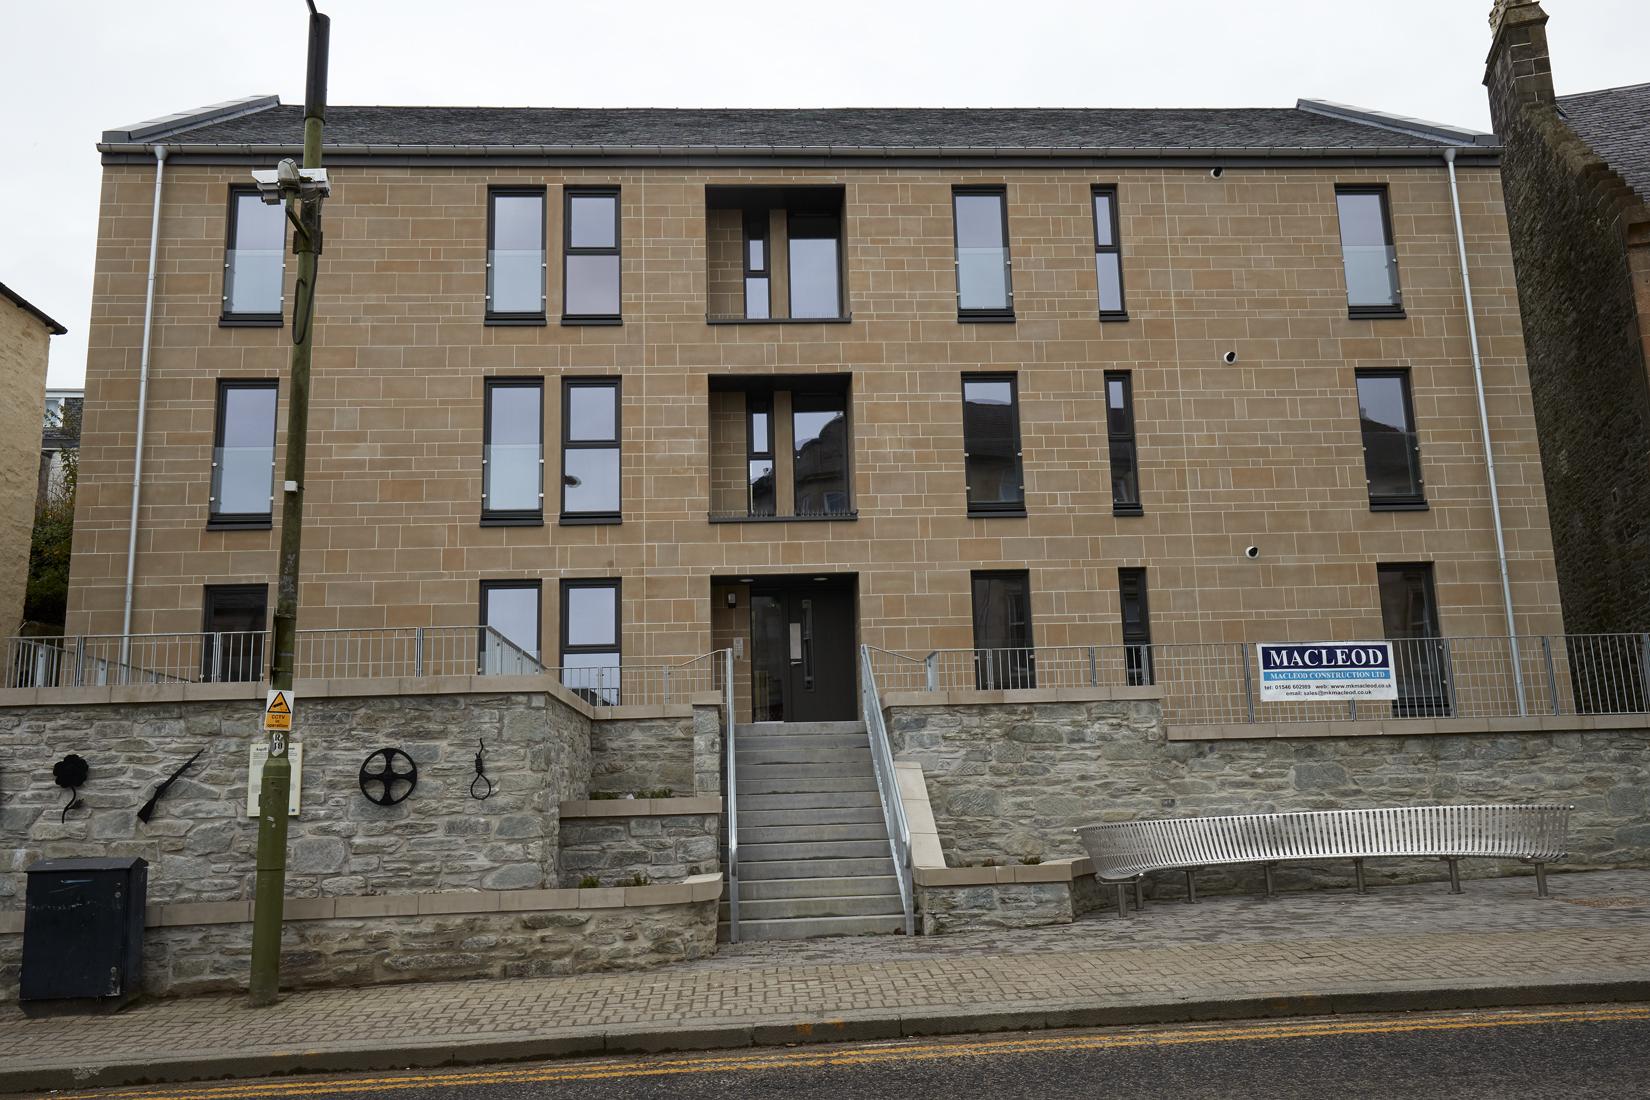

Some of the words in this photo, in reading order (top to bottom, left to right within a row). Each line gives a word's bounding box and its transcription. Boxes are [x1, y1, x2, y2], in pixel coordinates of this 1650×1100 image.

[1269, 648, 1383, 667] MACLEOD
[1270, 672, 1308, 680] MACLEOD
[1309, 671, 1370, 679] CONSTRUCTION
